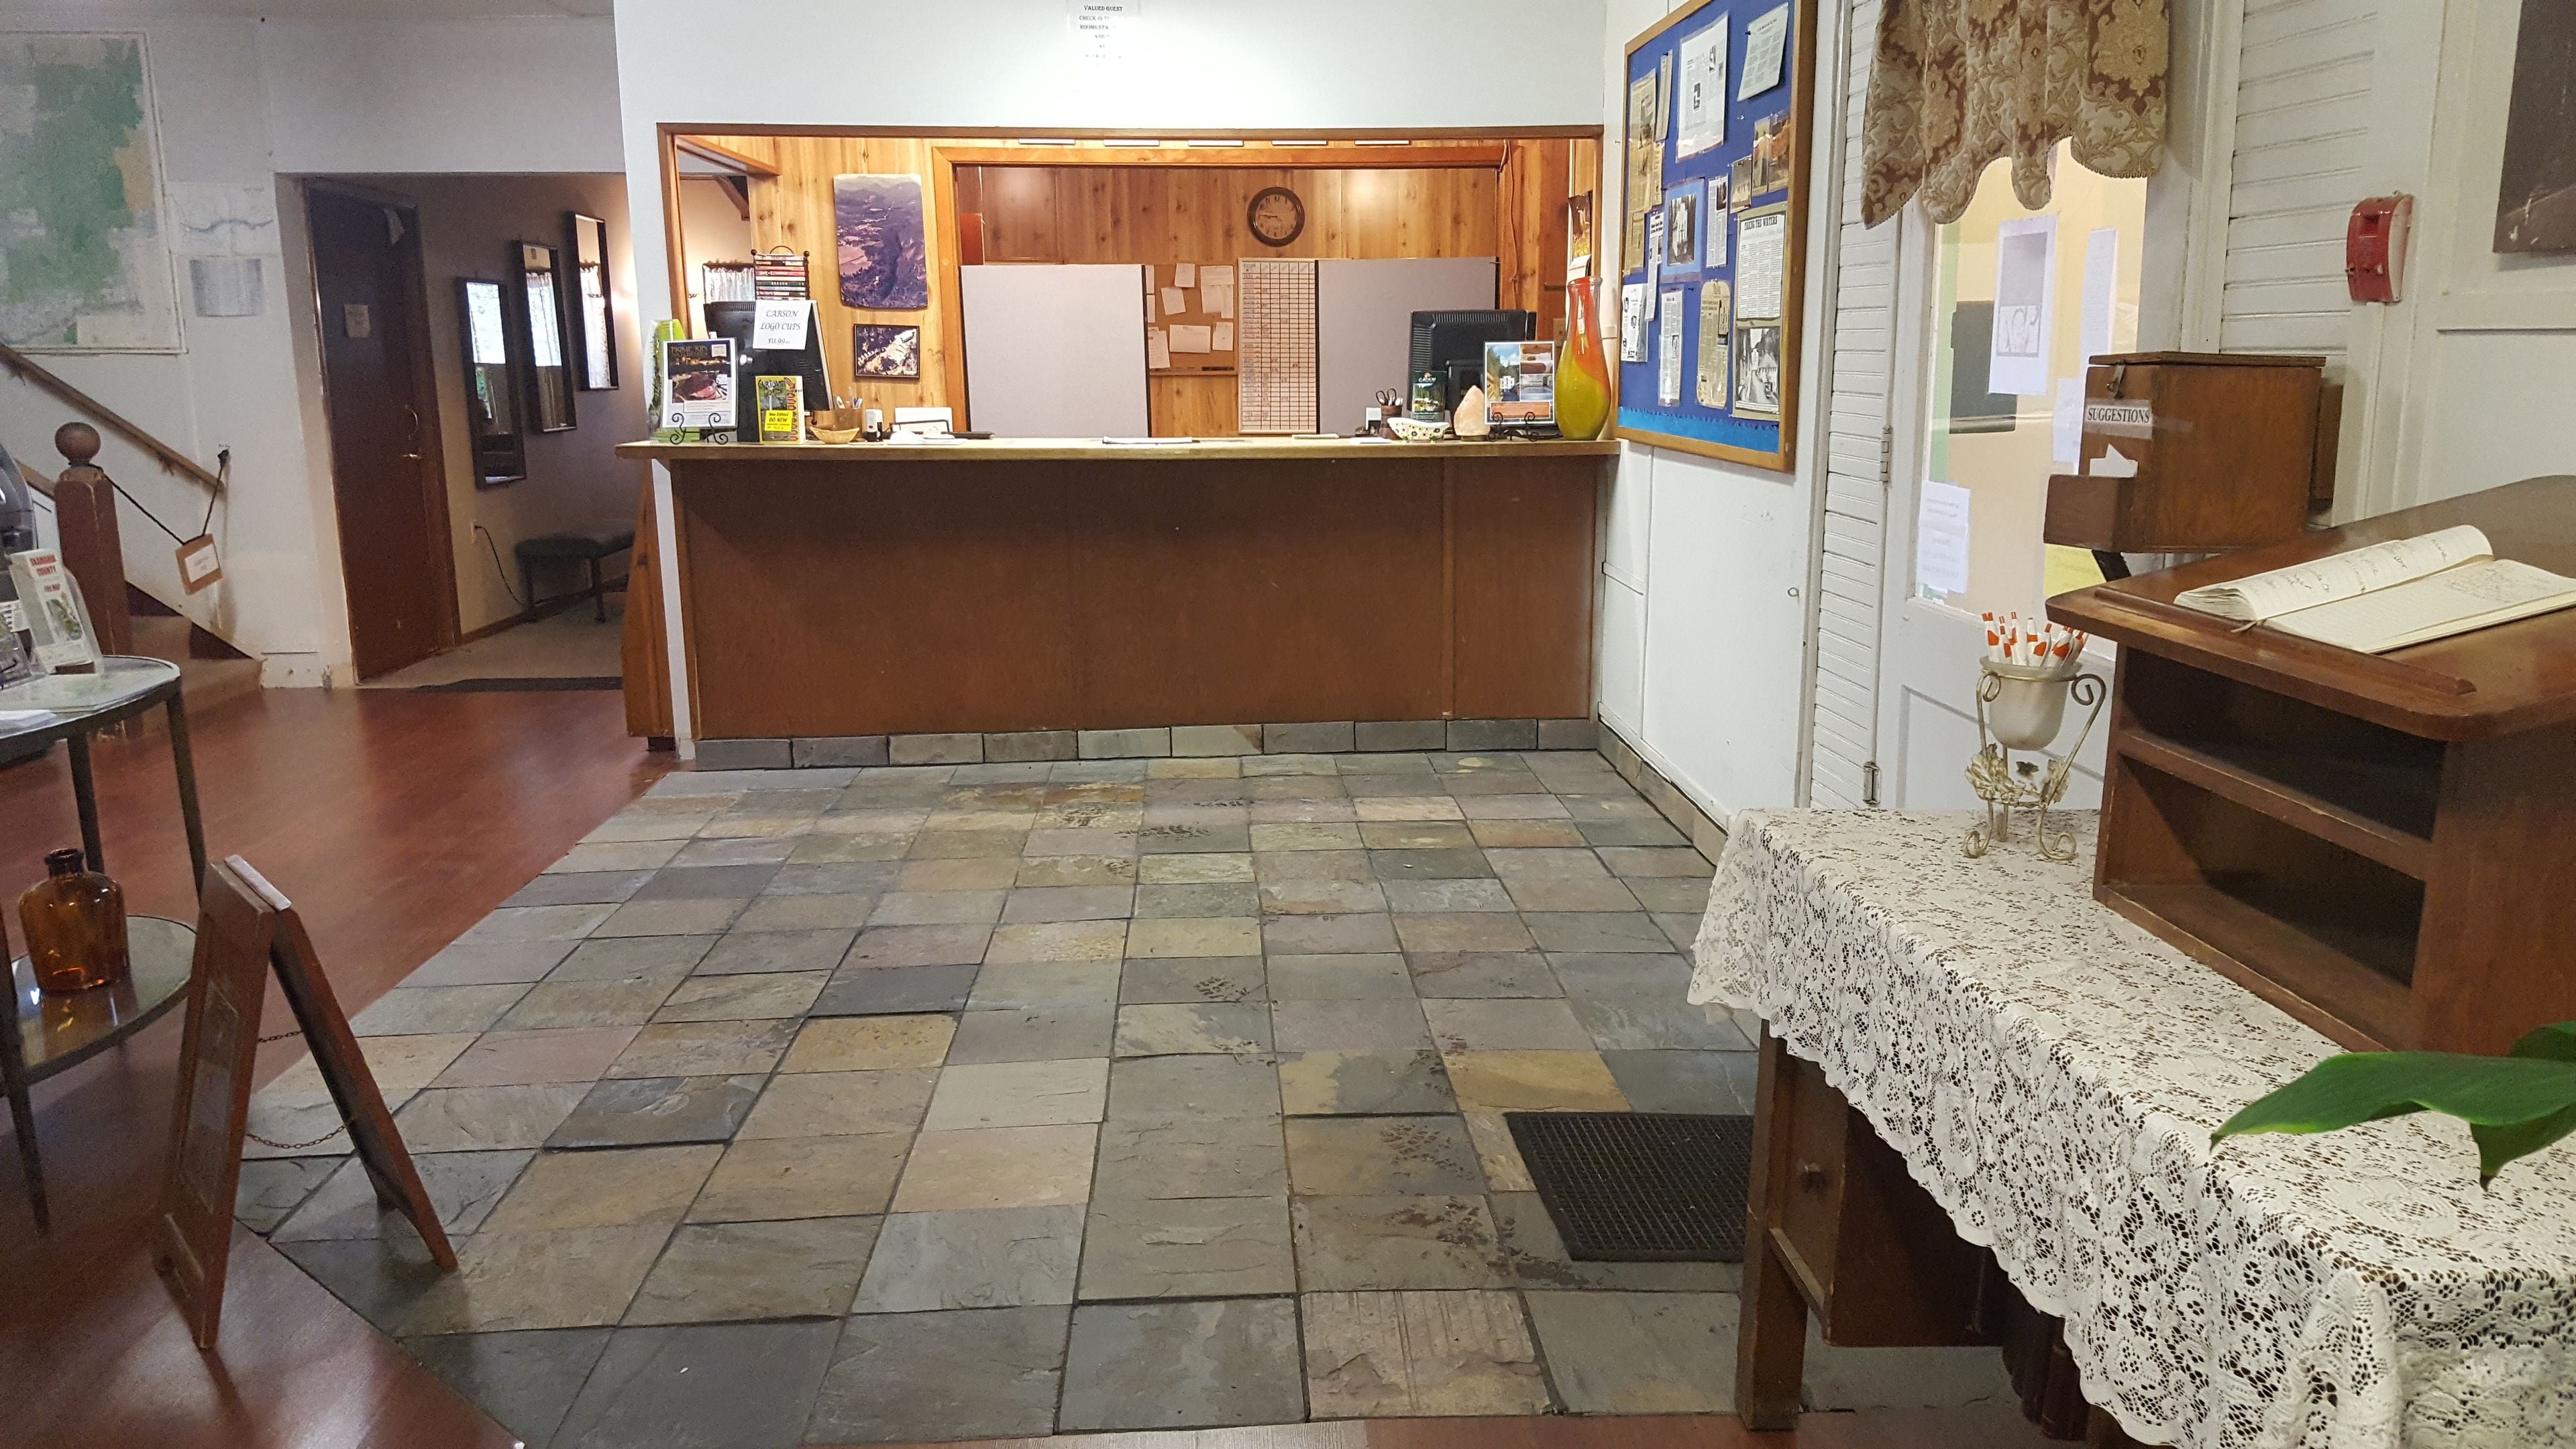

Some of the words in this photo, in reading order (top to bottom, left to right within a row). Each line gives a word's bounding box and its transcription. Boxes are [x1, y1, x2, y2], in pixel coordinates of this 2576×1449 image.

[1763, 215, 1778, 227] WATERS
[765, 309, 800, 317] CARSON
[759, 322, 781, 331] LOGO
[781, 322, 801, 331] CUPS
[2087, 407, 2150, 423] SUGGESTIONS
